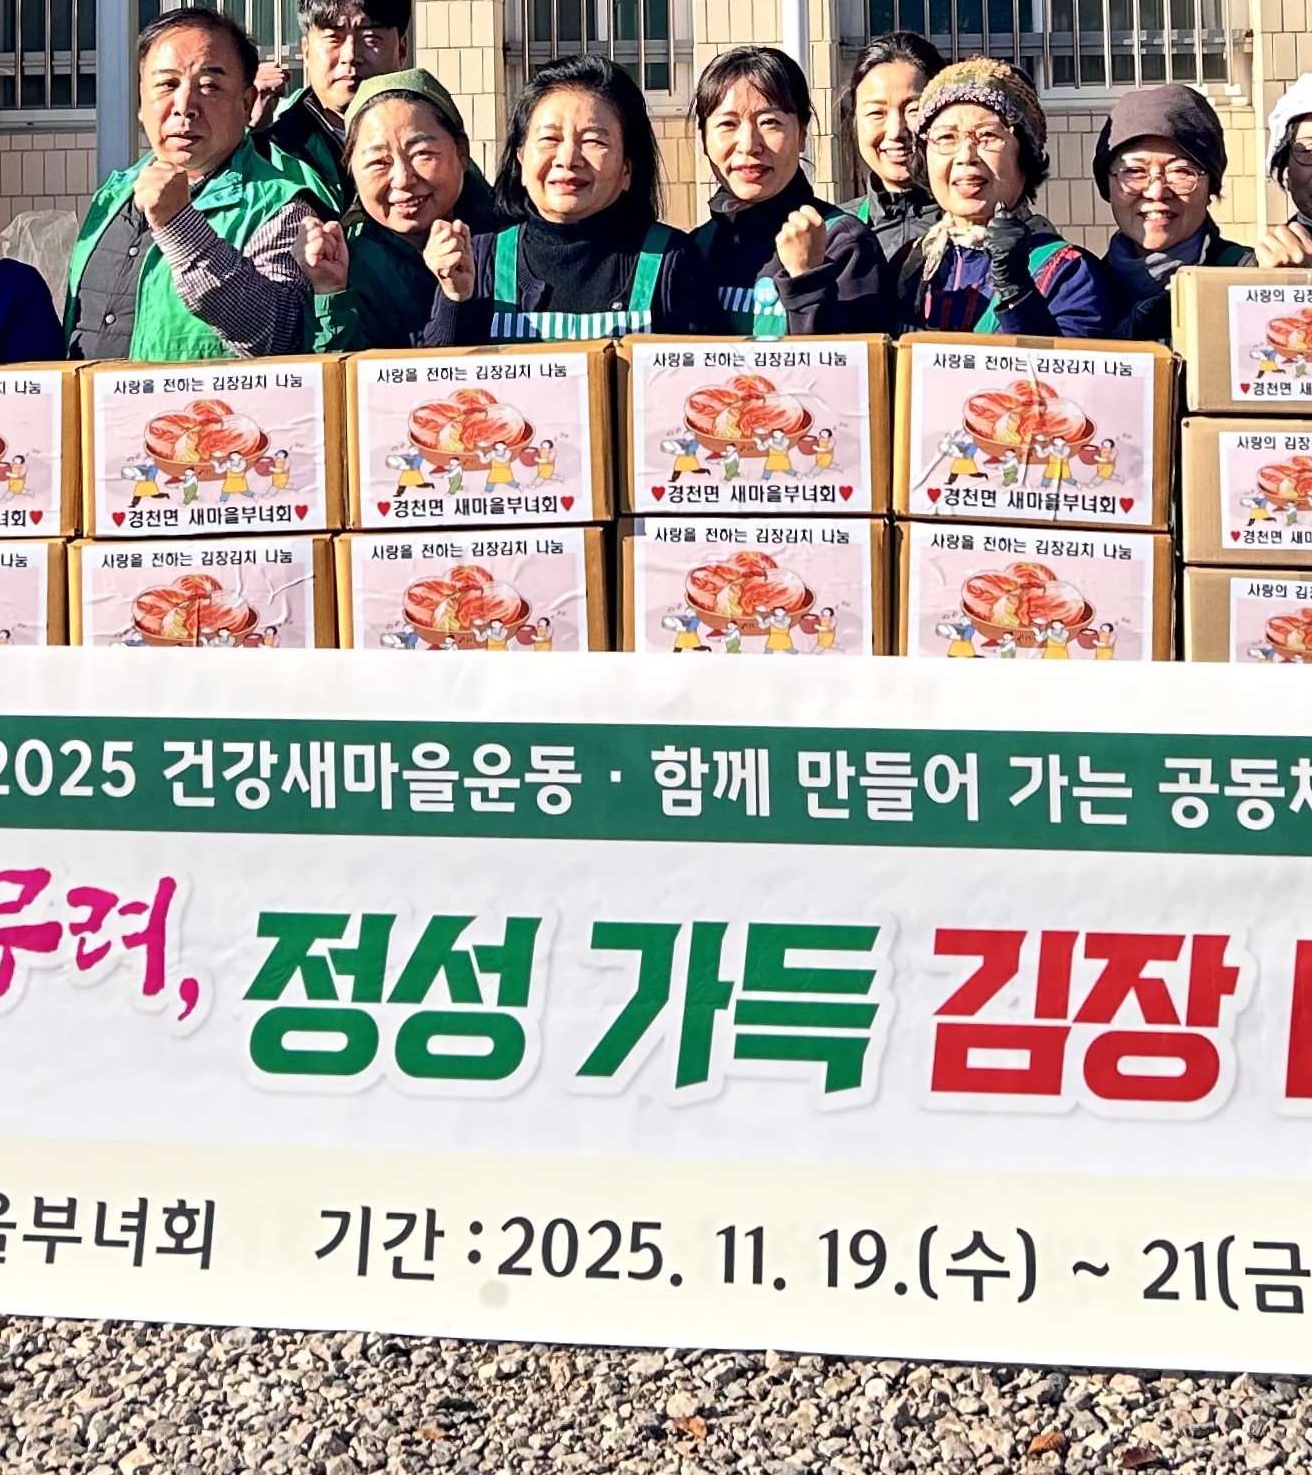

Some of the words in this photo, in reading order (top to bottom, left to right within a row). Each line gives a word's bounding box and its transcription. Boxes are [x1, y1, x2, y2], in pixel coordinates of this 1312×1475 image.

[1247, 290, 1284, 302] 사랑의
[653, 353, 694, 367] 사랑을
[705, 353, 741, 366] 전하는
[755, 353, 810, 366] 김장김치
[820, 352, 846, 366] 나눔
[934, 354, 975, 369] 사랑을
[985, 356, 1028, 371] 전하는
[1037, 357, 1095, 375] 김장김치
[1104, 361, 1132, 377] 나눔
[378, 369, 417, 383] 사랑을
[428, 367, 465, 381] 전하는
[477, 365, 530, 379] 김장김치
[541, 364, 566, 377] 나눔
[15, 381, 40, 394] 나눔
[114, 380, 153, 394] 사랑을
[164, 378, 202, 392] 전하는
[214, 375, 266, 390] 김장김치
[277, 374, 301, 387] 나눔
[1254, 383, 1291, 395] 경천면
[1238, 437, 1275, 449] 사랑의
[669, 486, 719, 504] 경천면
[731, 484, 836, 503] 새마을부녀회
[944, 488, 997, 508] 경천면
[1007, 490, 1116, 514] 새마을부녀회
[393, 500, 444, 518] 경천면
[455, 496, 557, 515] 새마을부녀회
[128, 510, 179, 529] 경천면
[189, 505, 292, 525] 새마을부녀회
[655, 528, 695, 542] 사랑을
[706, 528, 745, 542] 전하는
[757, 529, 812, 543] 김장김치
[822, 530, 849, 544] 나눔
[1245, 530, 1281, 544] 경천면
[372, 545, 412, 559] 사랑을
[422, 543, 462, 558] 전하는
[472, 541, 526, 556] 김장김치
[537, 540, 562, 554] 나눔
[932, 534, 973, 550] 사랑을
[984, 537, 1025, 553] 전하는
[1036, 540, 1094, 557] 김장김치
[1104, 543, 1131, 559] 나눔
[1, 554, 27, 567] 나눔
[102, 554, 142, 568] 사랑을
[153, 552, 191, 567] 전하는
[202, 550, 256, 565] 김장김치
[266, 550, 292, 563] 나눔
[1249, 584, 1286, 597] 사랑의
[162, 739, 582, 817] 건강새마을운동
[651, 745, 772, 819] 함께
[798, 748, 981, 823] 만들어
[1008, 753, 1134, 827] 가는
[244, 911, 542, 1079] 정성
[577, 919, 881, 1092] 가득
[929, 929, 1239, 1101] 김장
[715, 1223, 786, 1290] 11.
